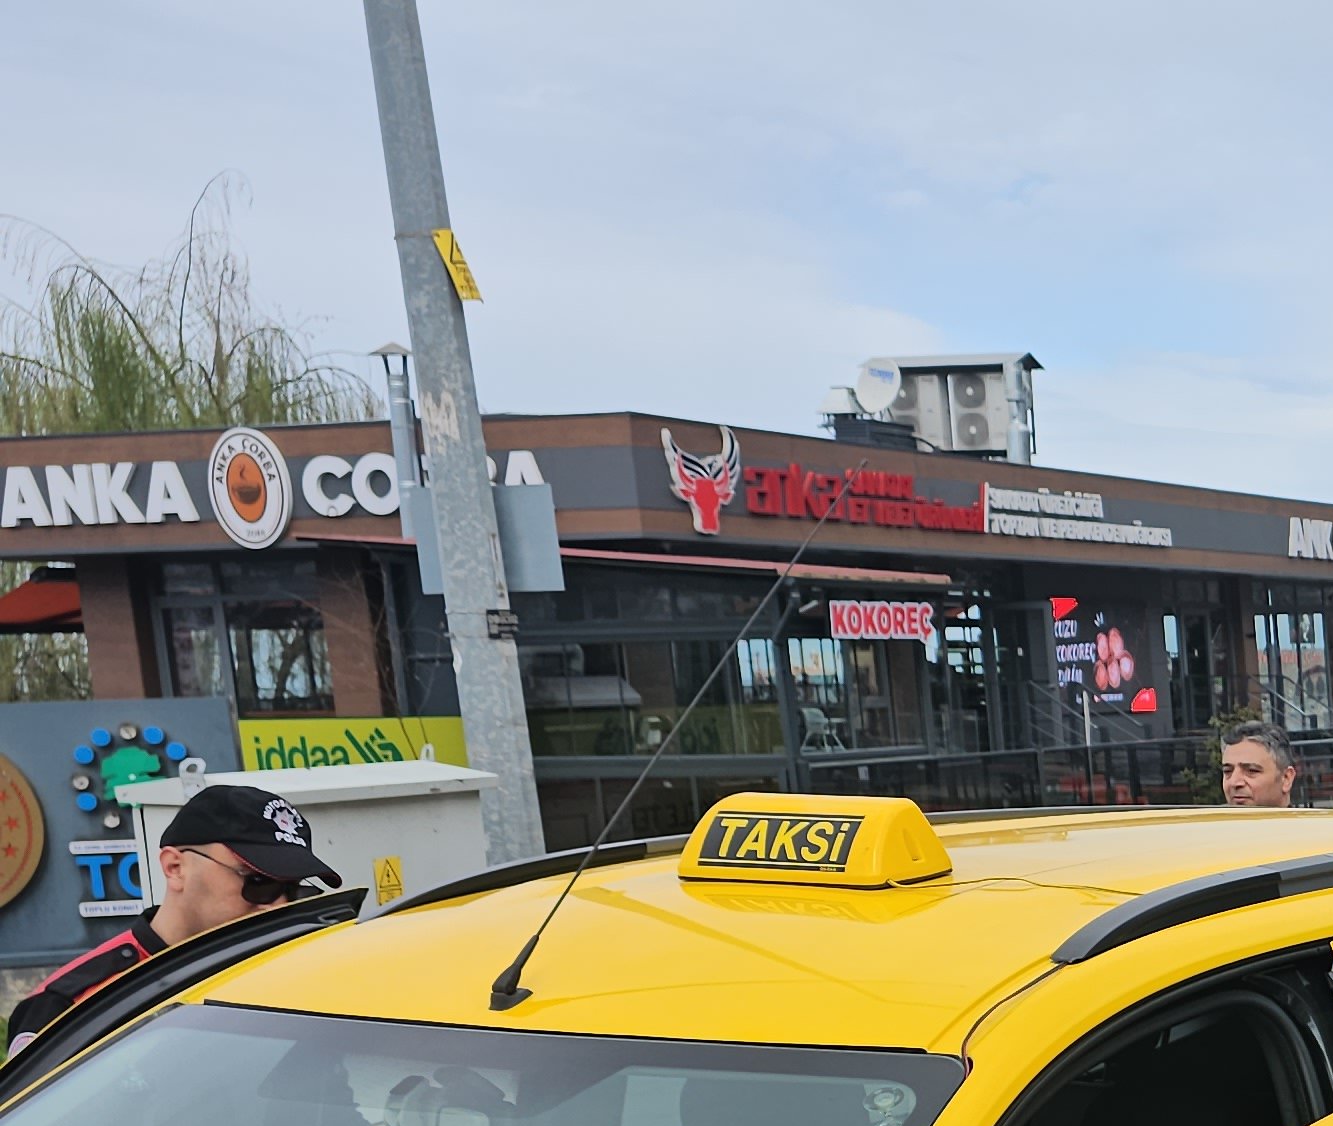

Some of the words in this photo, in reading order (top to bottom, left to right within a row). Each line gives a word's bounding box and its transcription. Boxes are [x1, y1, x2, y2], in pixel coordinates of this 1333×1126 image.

[216, 445, 235, 484] ANKA
[1, 460, 200, 527] ANKA
[830, 602, 932, 641] KOKOREÇ
[254, 736, 350, 770] iddaa
